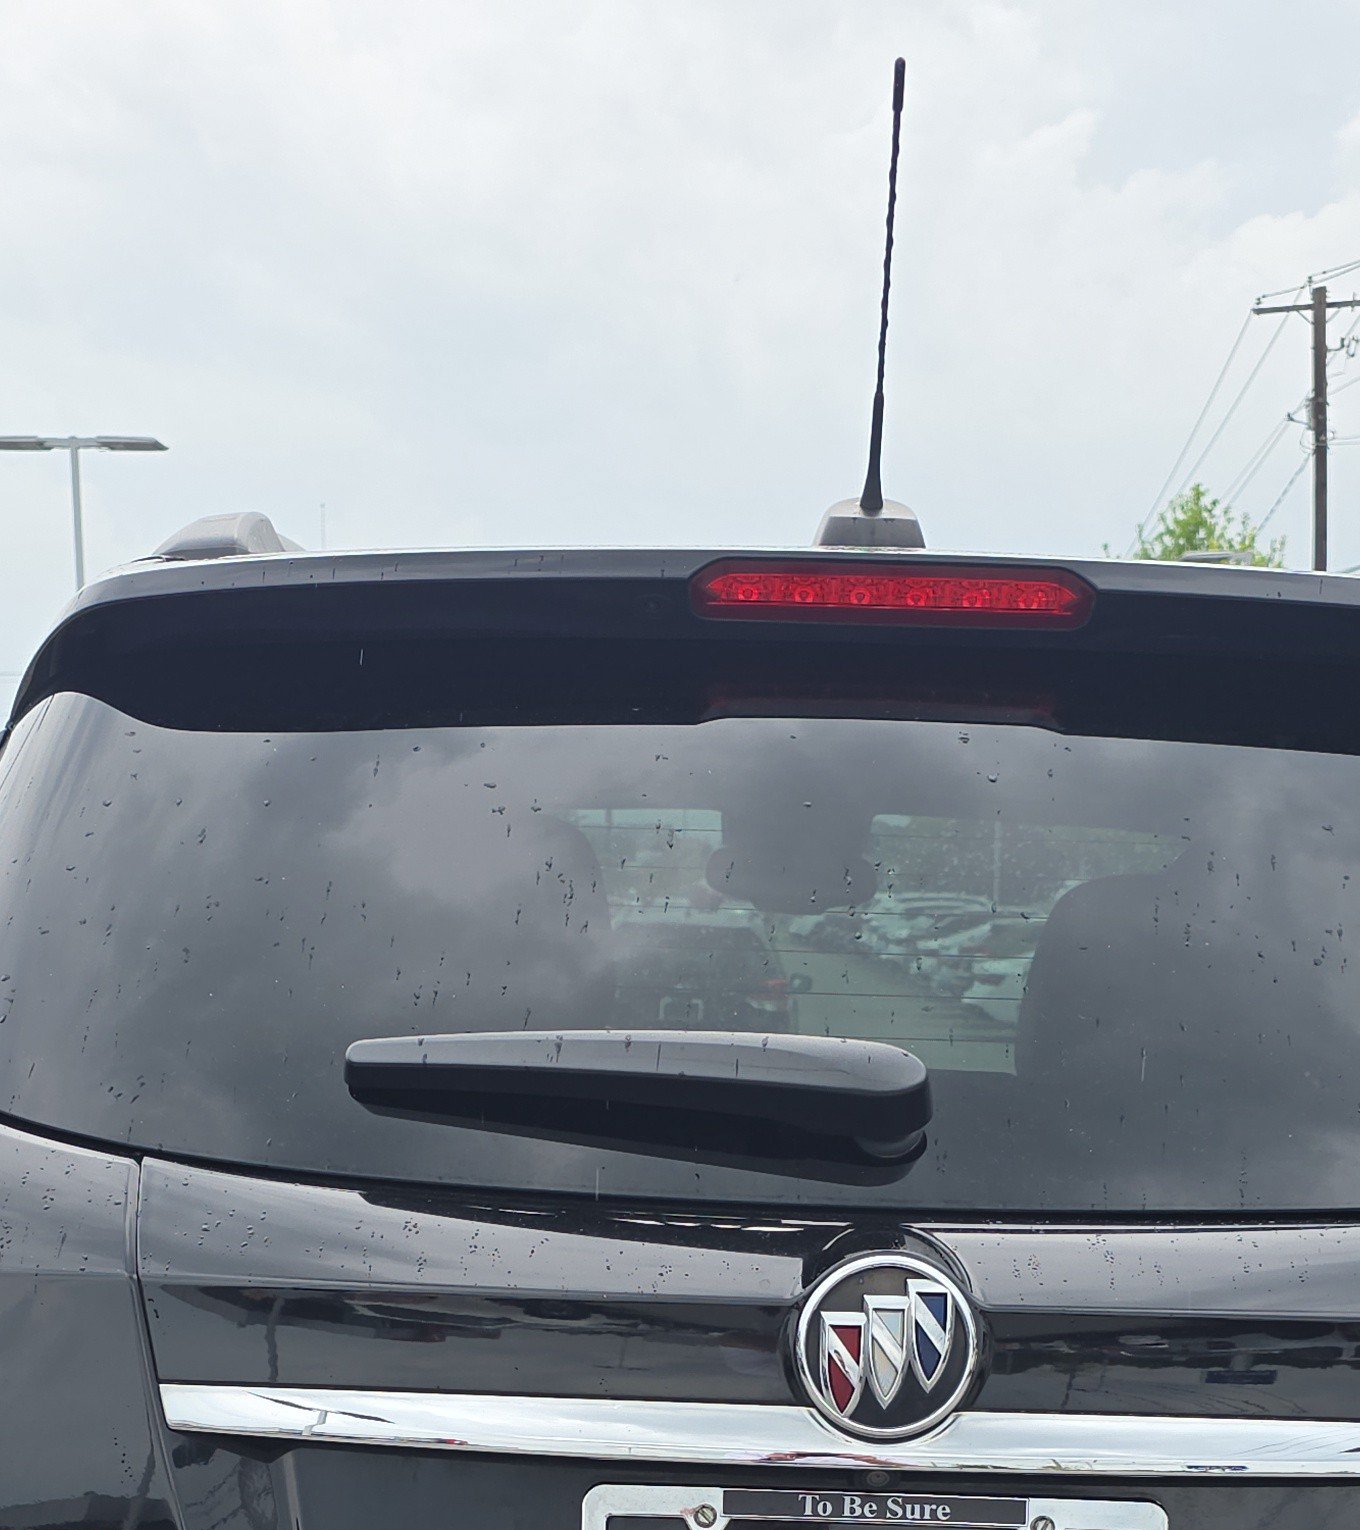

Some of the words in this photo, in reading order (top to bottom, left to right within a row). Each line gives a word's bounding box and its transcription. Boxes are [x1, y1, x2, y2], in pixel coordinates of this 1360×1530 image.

[797, 1494, 833, 1517] To
[843, 1495, 877, 1519] Be
[886, 1497, 952, 1520] Sure
